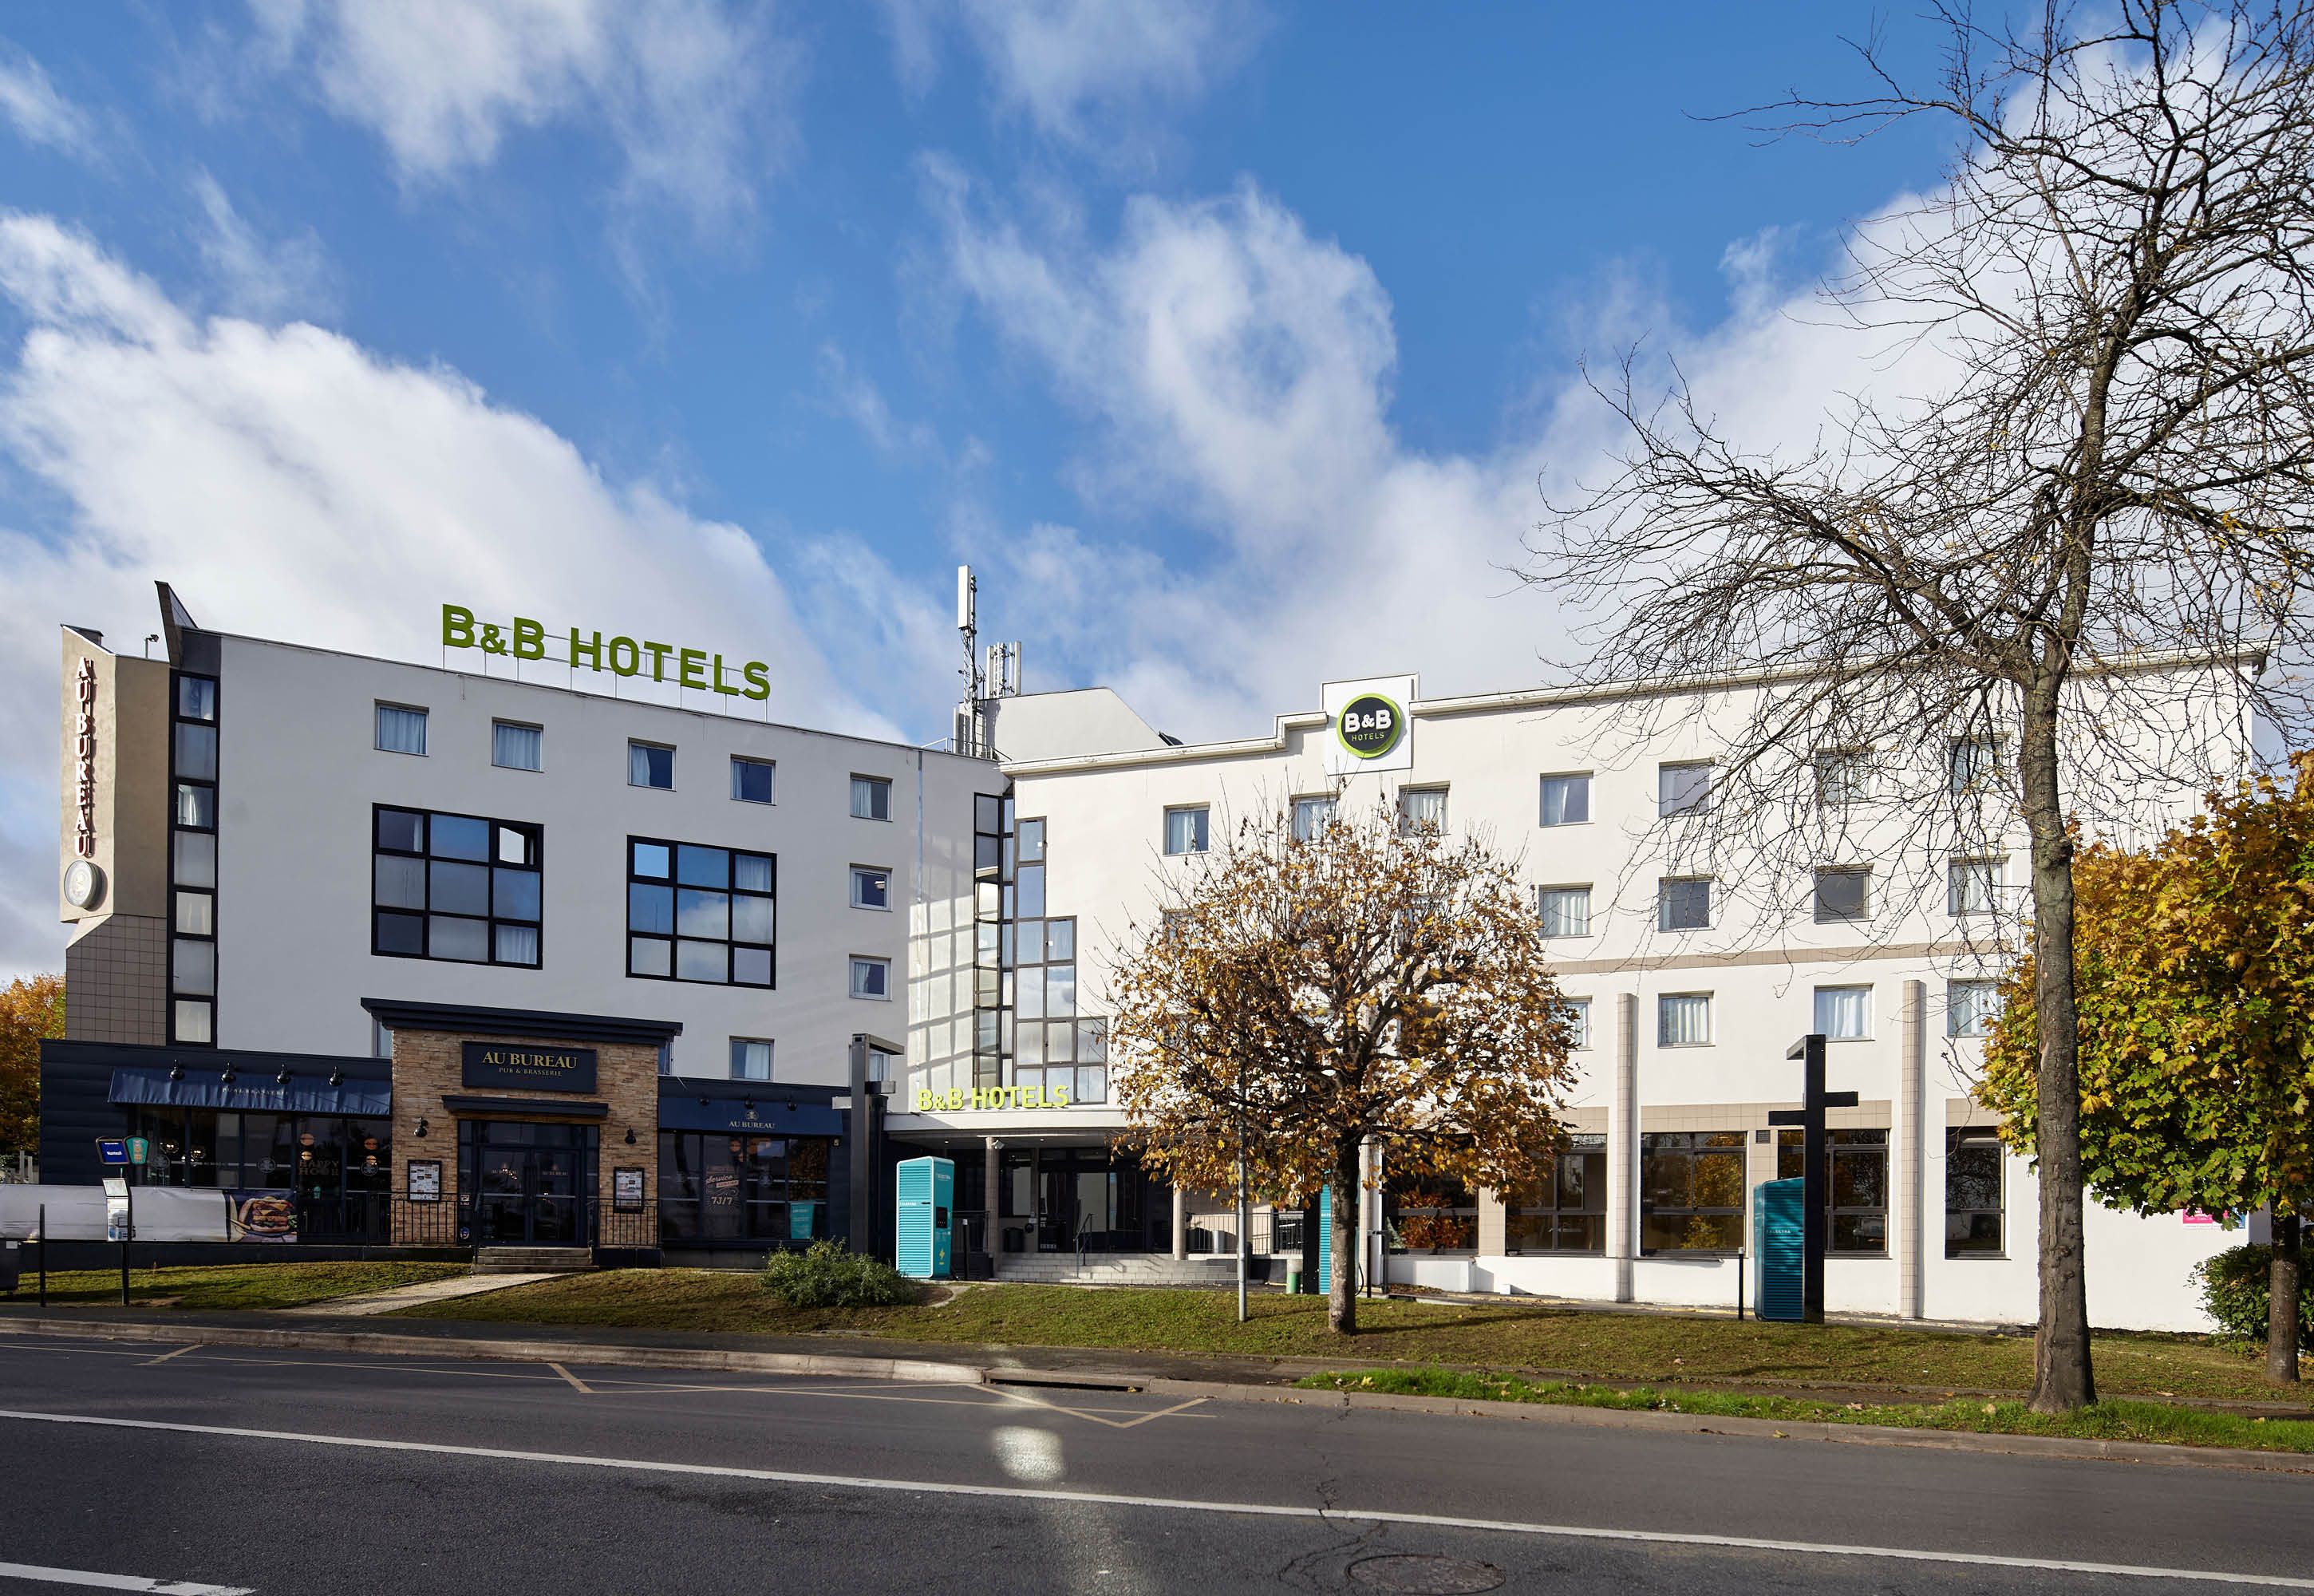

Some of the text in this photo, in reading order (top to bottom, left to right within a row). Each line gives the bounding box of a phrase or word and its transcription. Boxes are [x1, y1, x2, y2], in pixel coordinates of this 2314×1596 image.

[442, 604, 771, 700] B&B HOTELS
[1345, 709, 1392, 733] B&B
[1352, 733, 1384, 741] HOTELS
[74, 656, 91, 856] AU BUREAU
[482, 1052, 578, 1069] AU BUREAU
[918, 1084, 1069, 1111] B&B HOTELS
